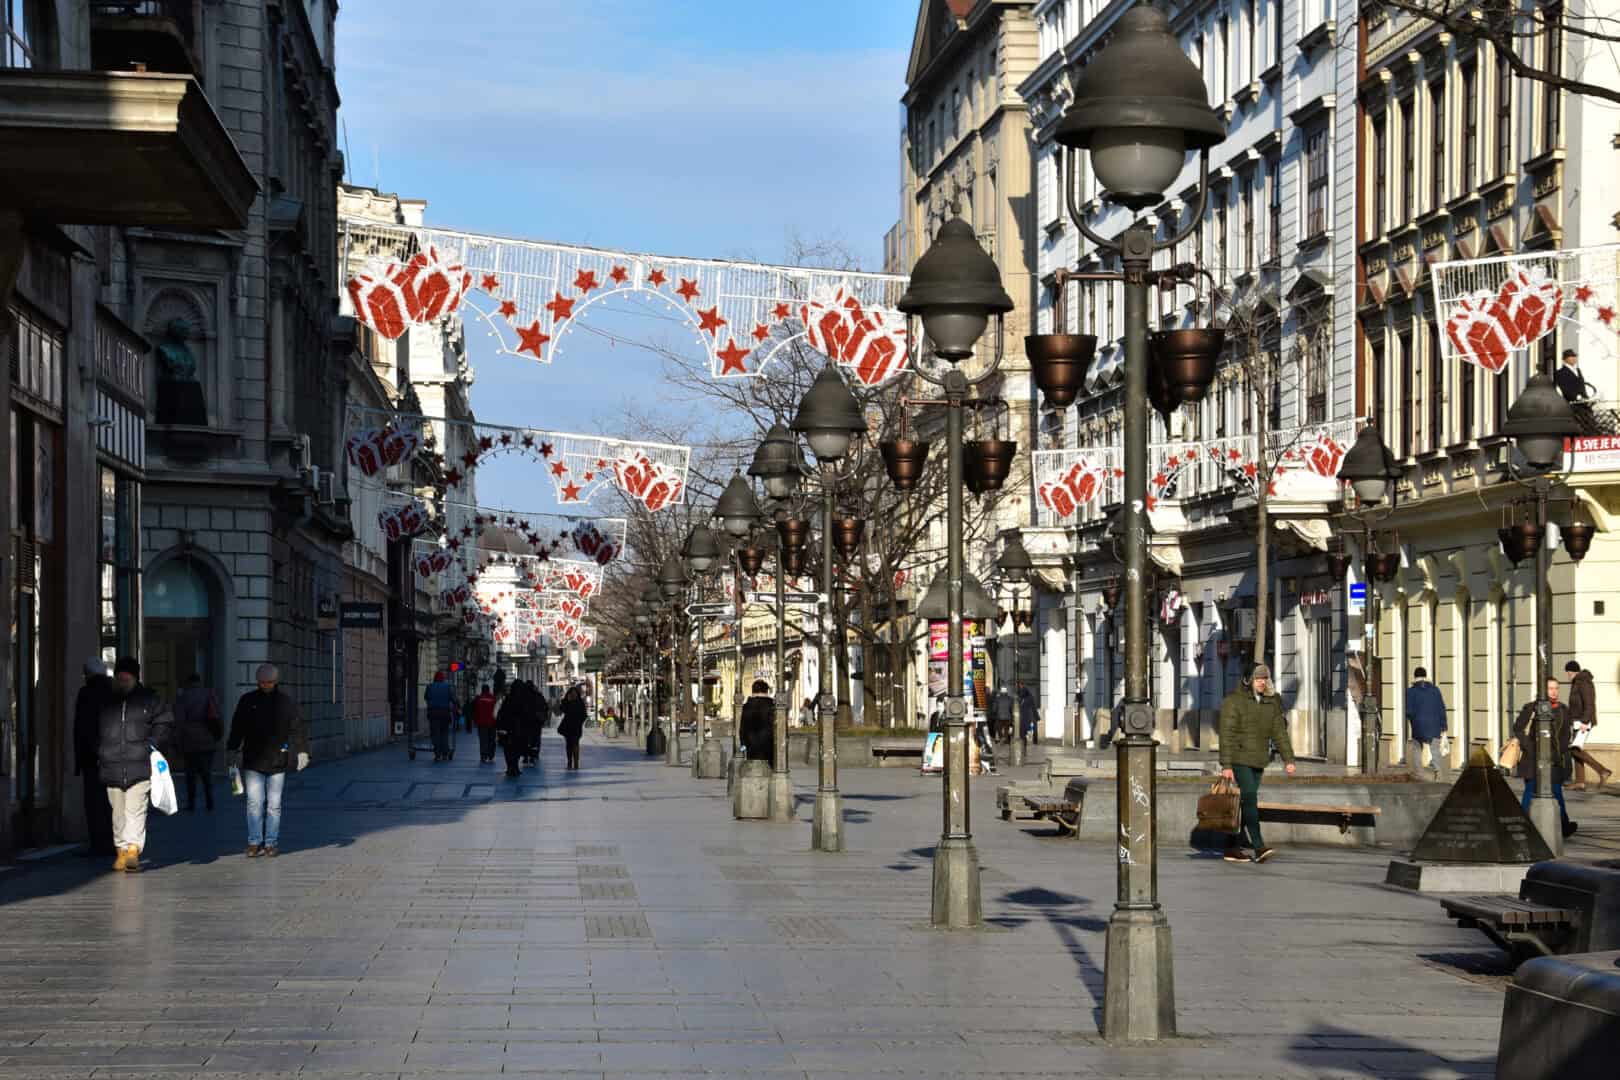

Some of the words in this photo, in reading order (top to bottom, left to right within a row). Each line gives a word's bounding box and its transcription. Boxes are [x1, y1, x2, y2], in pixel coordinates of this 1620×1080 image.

[1575, 439, 1582, 451] A
[1583, 438, 1599, 450] SVE
[1600, 437, 1610, 450] JE
